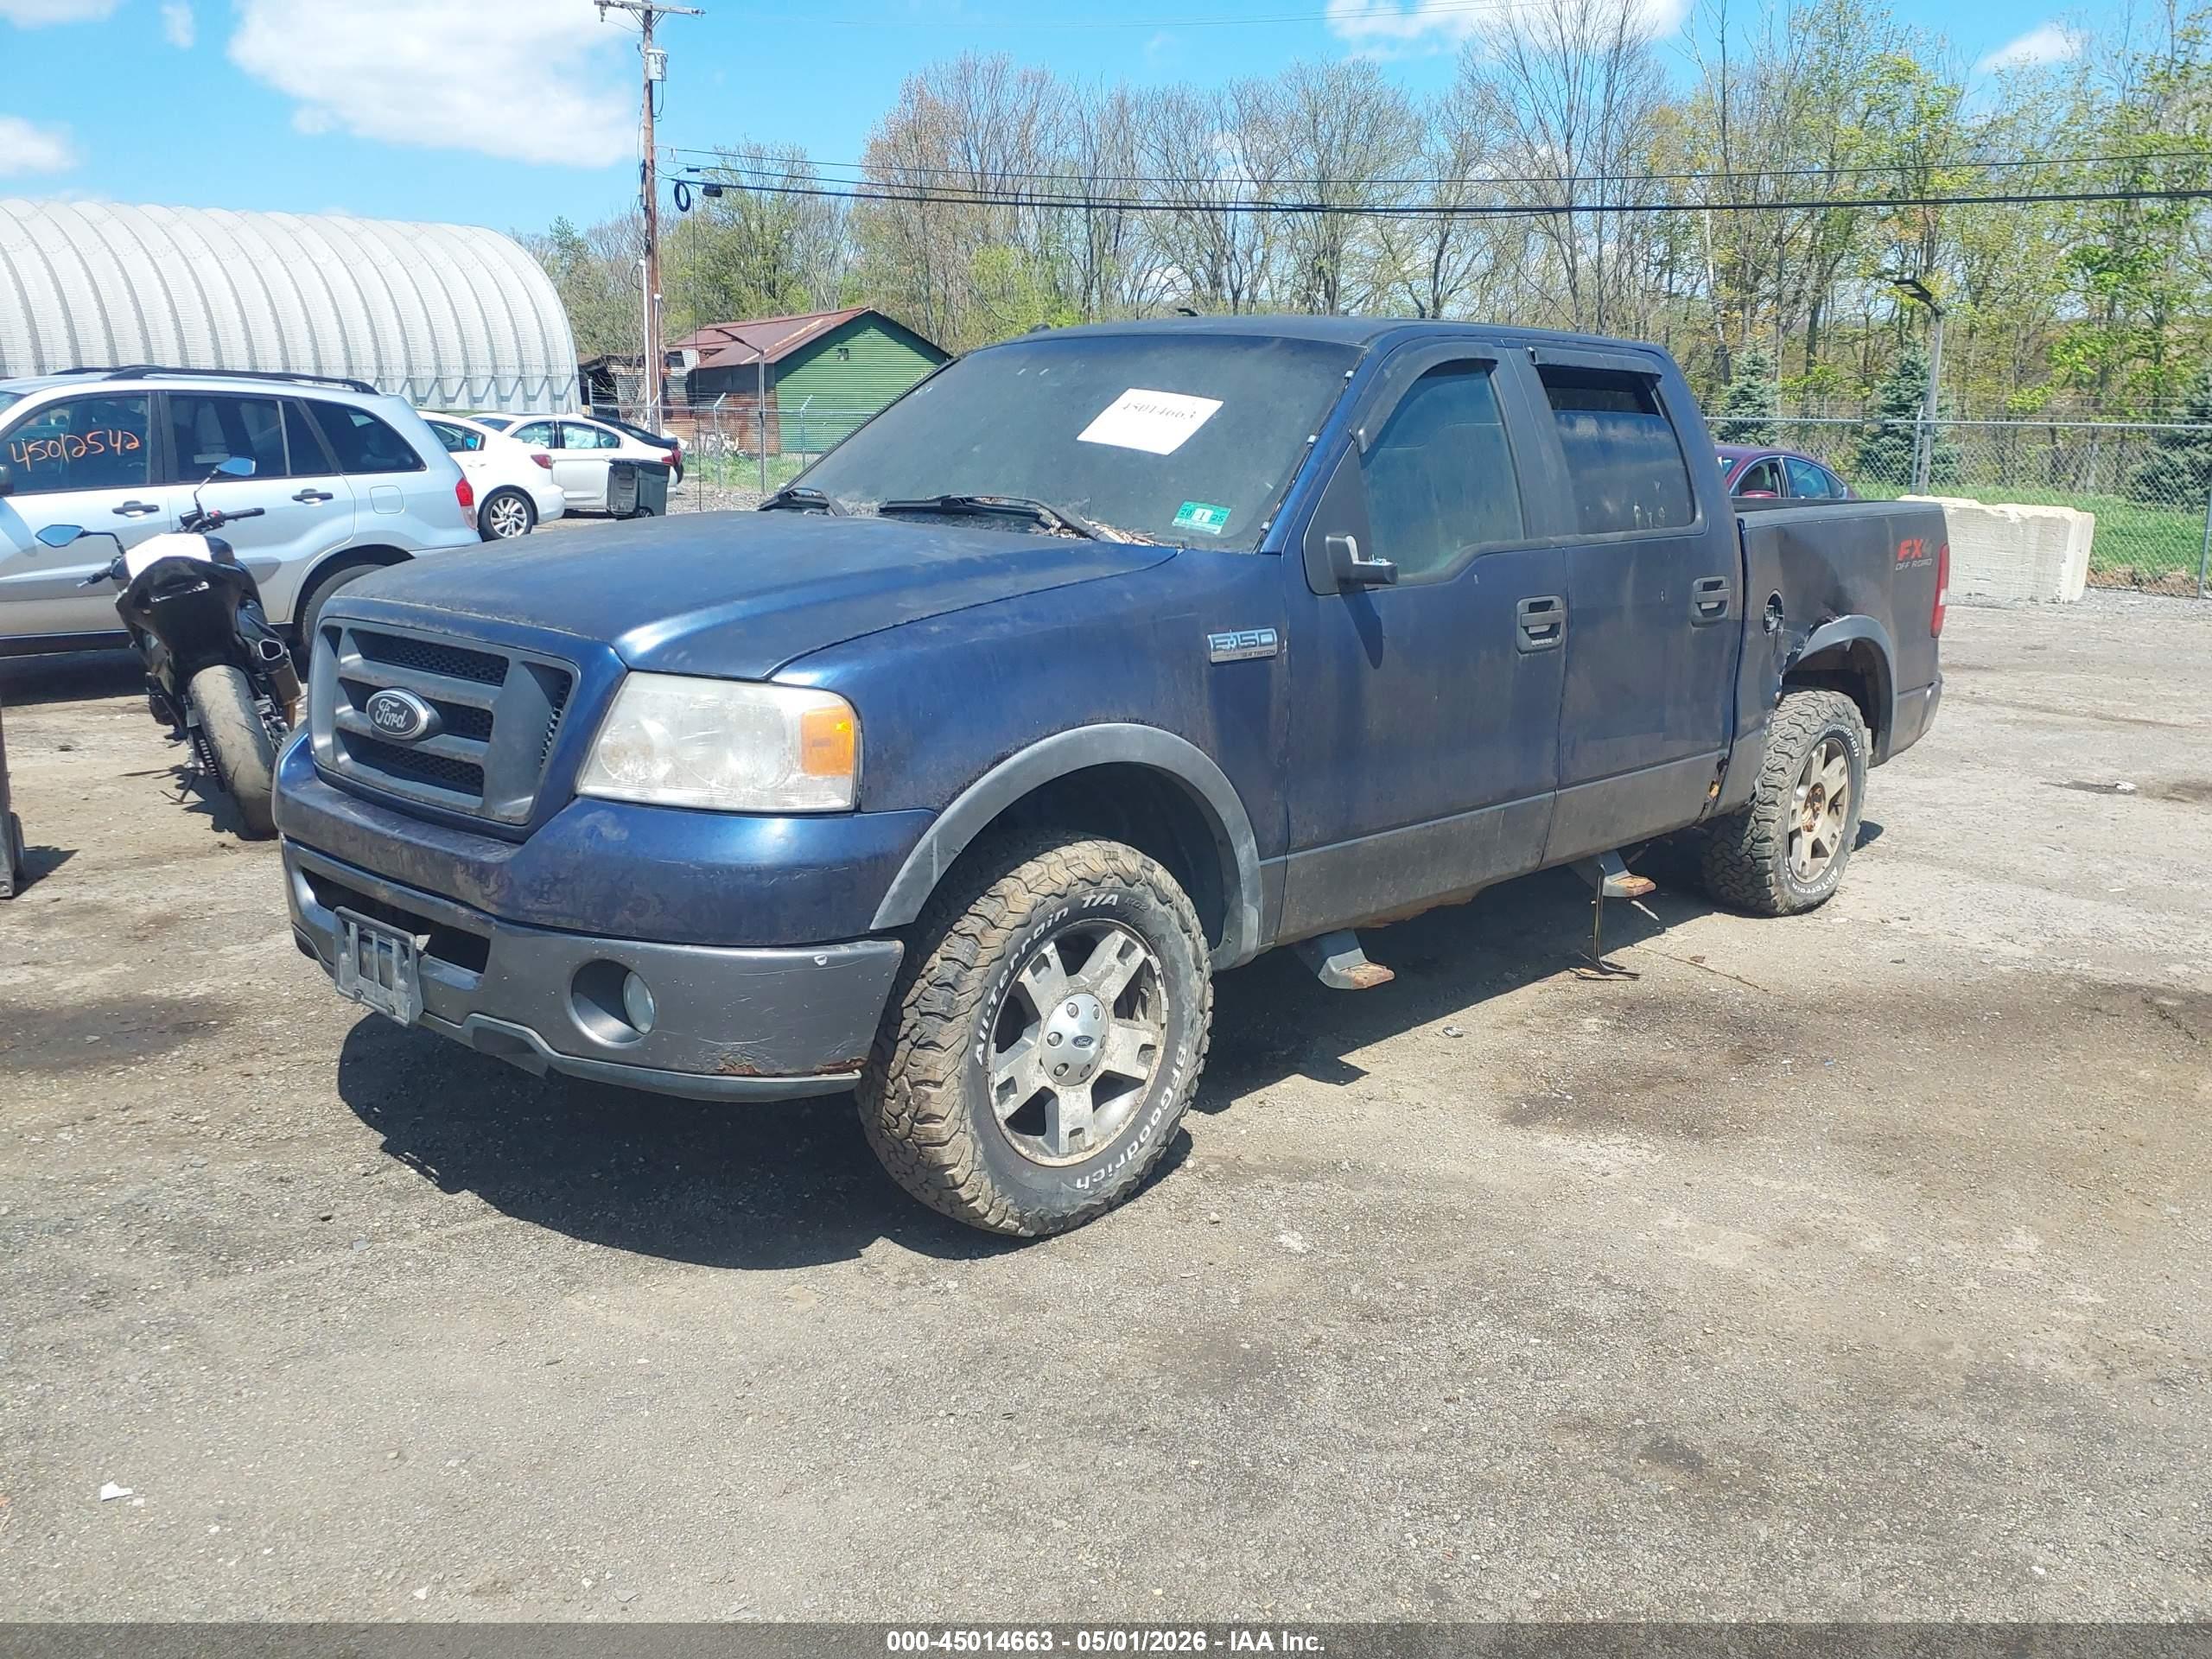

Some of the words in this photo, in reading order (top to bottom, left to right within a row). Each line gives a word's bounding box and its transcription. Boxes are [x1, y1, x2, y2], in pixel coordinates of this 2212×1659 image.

[10, 429, 141, 473] 45012542
[1895, 561, 1911, 571] OFF
[1911, 558, 1933, 568] ROAD
[375, 698, 408, 729] Ford
[976, 906, 1069, 1065] All-Terrain
[1082, 893, 1119, 909] T/A
[1076, 1046, 1187, 1190] BFGoodrich
